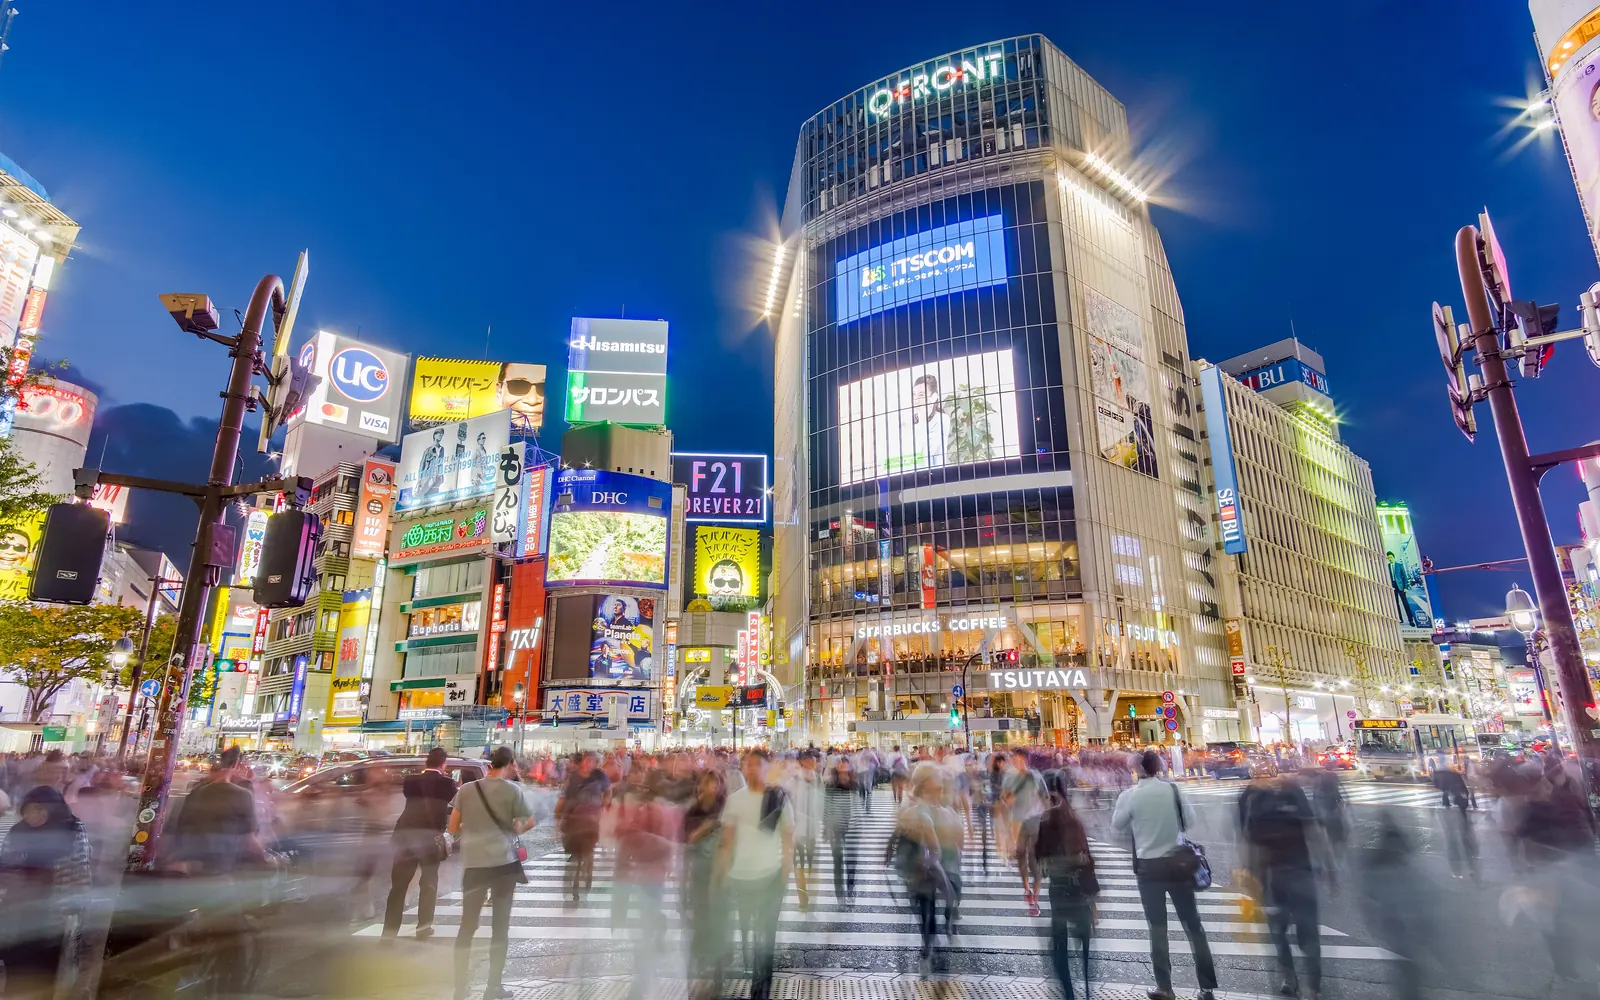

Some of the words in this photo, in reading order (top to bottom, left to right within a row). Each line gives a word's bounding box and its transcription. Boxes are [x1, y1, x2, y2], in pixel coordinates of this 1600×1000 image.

[869, 53, 1002, 117] QFRONT
[571, 336, 665, 353] Hisamitsu
[420, 374, 493, 391] ヤバババーン
[571, 386, 660, 406] サロンパス
[363, 416, 388, 430] VISA
[404, 472, 416, 483] ALL
[438, 463, 456, 475] BEST
[692, 461, 741, 493] F21
[494, 447, 521, 538] もんじゃ
[591, 491, 628, 505] DHC
[686, 497, 741, 513] OREVER
[746, 498, 761, 513] 21
[1218, 488, 1240, 543] SEIBU
[700, 531, 754, 547] ヤバババーン
[412, 622, 459, 636] Euphoria
[604, 630, 641, 640] Planets
[858, 620, 940, 639] STARBUCKS
[949, 617, 1007, 631] COFFEE
[506, 616, 542, 670] クスリ
[990, 670, 1087, 688] TSUTAYA
[551, 694, 646, 713] 大盛堂店
[222, 715, 259, 728] グルメタウン
